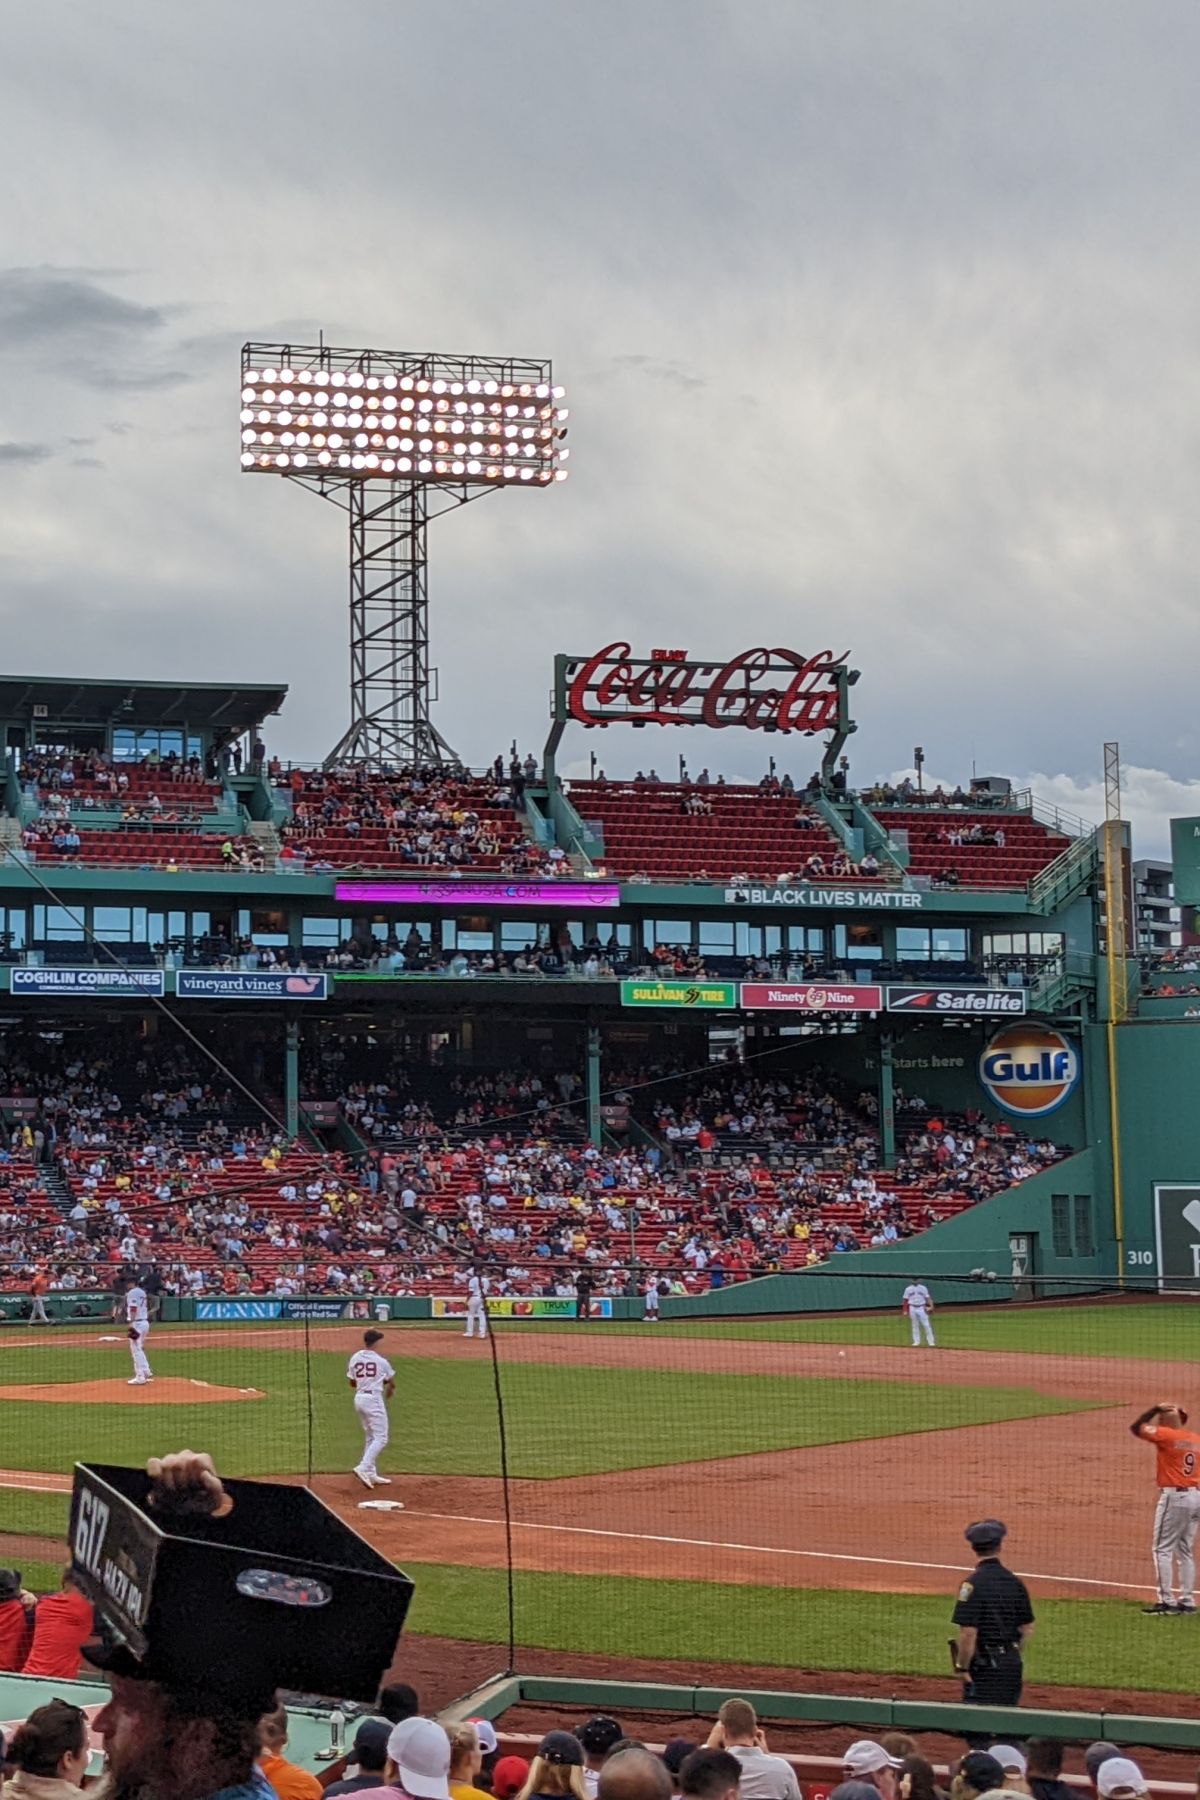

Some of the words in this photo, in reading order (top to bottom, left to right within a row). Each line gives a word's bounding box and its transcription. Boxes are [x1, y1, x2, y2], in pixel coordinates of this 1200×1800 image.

[569, 642, 851, 731] Coca-Cola
[751, 889, 806, 904] BLACK
[810, 890, 855, 906] LIVES
[859, 892, 922, 907] MATTER
[14, 971, 75, 984] COGHLIN
[78, 973, 161, 985] COMPANIES
[183, 976, 243, 993] vineyard
[243, 978, 282, 991] vines
[633, 987, 684, 1000] SULLIVAN
[702, 990, 725, 1001] TIRE
[768, 990, 806, 1004] Ninety
[827, 992, 855, 1004] Nine
[936, 992, 1022, 1011] Safelite
[894, 1057, 929, 1069] starts
[931, 1055, 964, 1068] here
[984, 1051, 1069, 1082] Gulf
[1128, 1251, 1153, 1265] 310
[200, 1303, 280, 1318] ZENNI
[314, 1303, 341, 1312] Eyewear
[543, 1301, 570, 1309] TRULY
[354, 1362, 377, 1378] 29
[1184, 1453, 1195, 1476] 9
